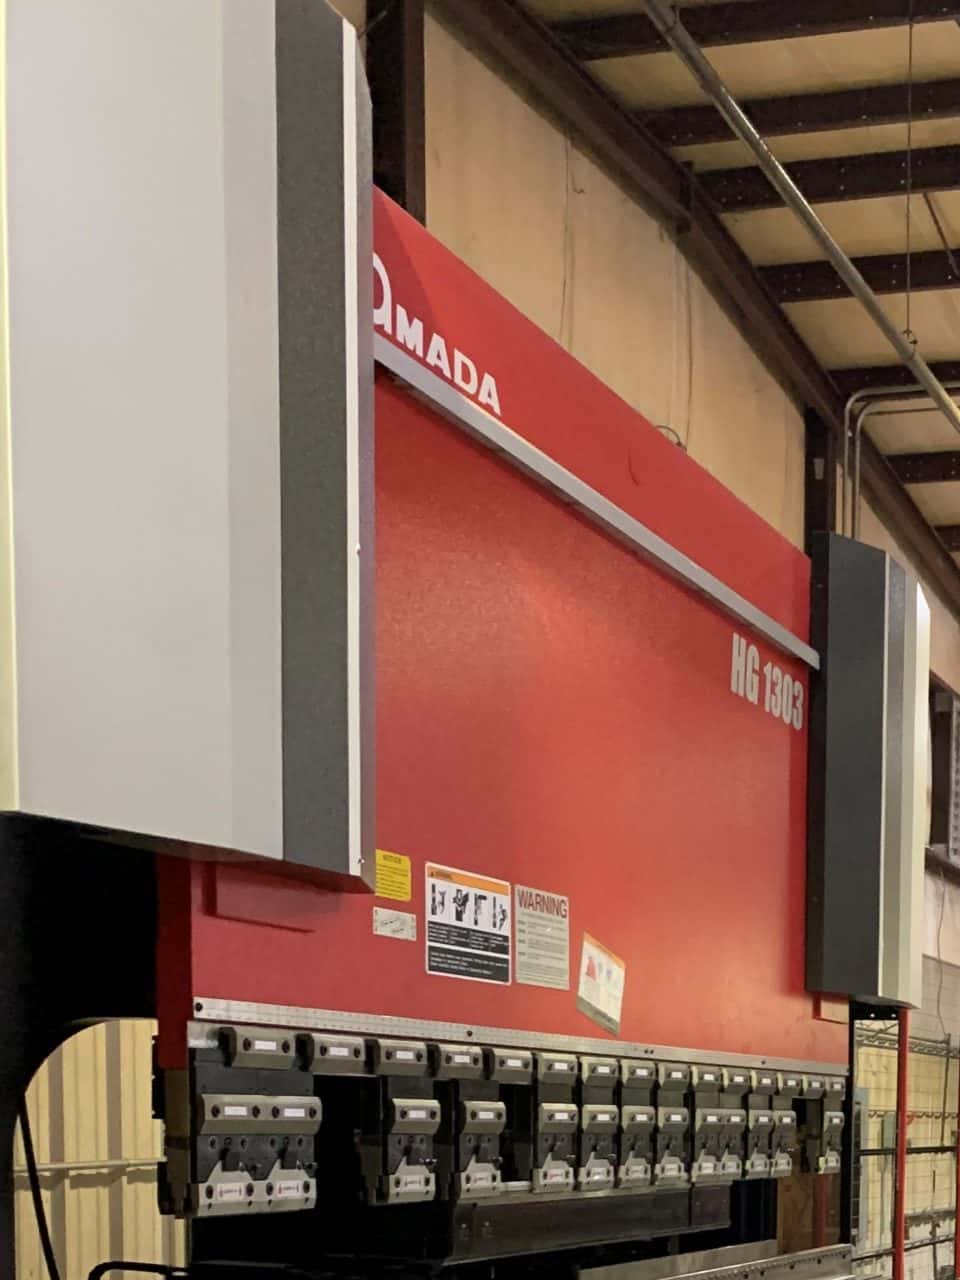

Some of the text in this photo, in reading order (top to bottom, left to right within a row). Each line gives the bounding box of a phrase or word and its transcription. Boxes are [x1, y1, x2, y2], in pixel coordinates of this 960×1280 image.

[730, 631, 804, 730] HG 1303
[517, 889, 568, 919] WARNING
